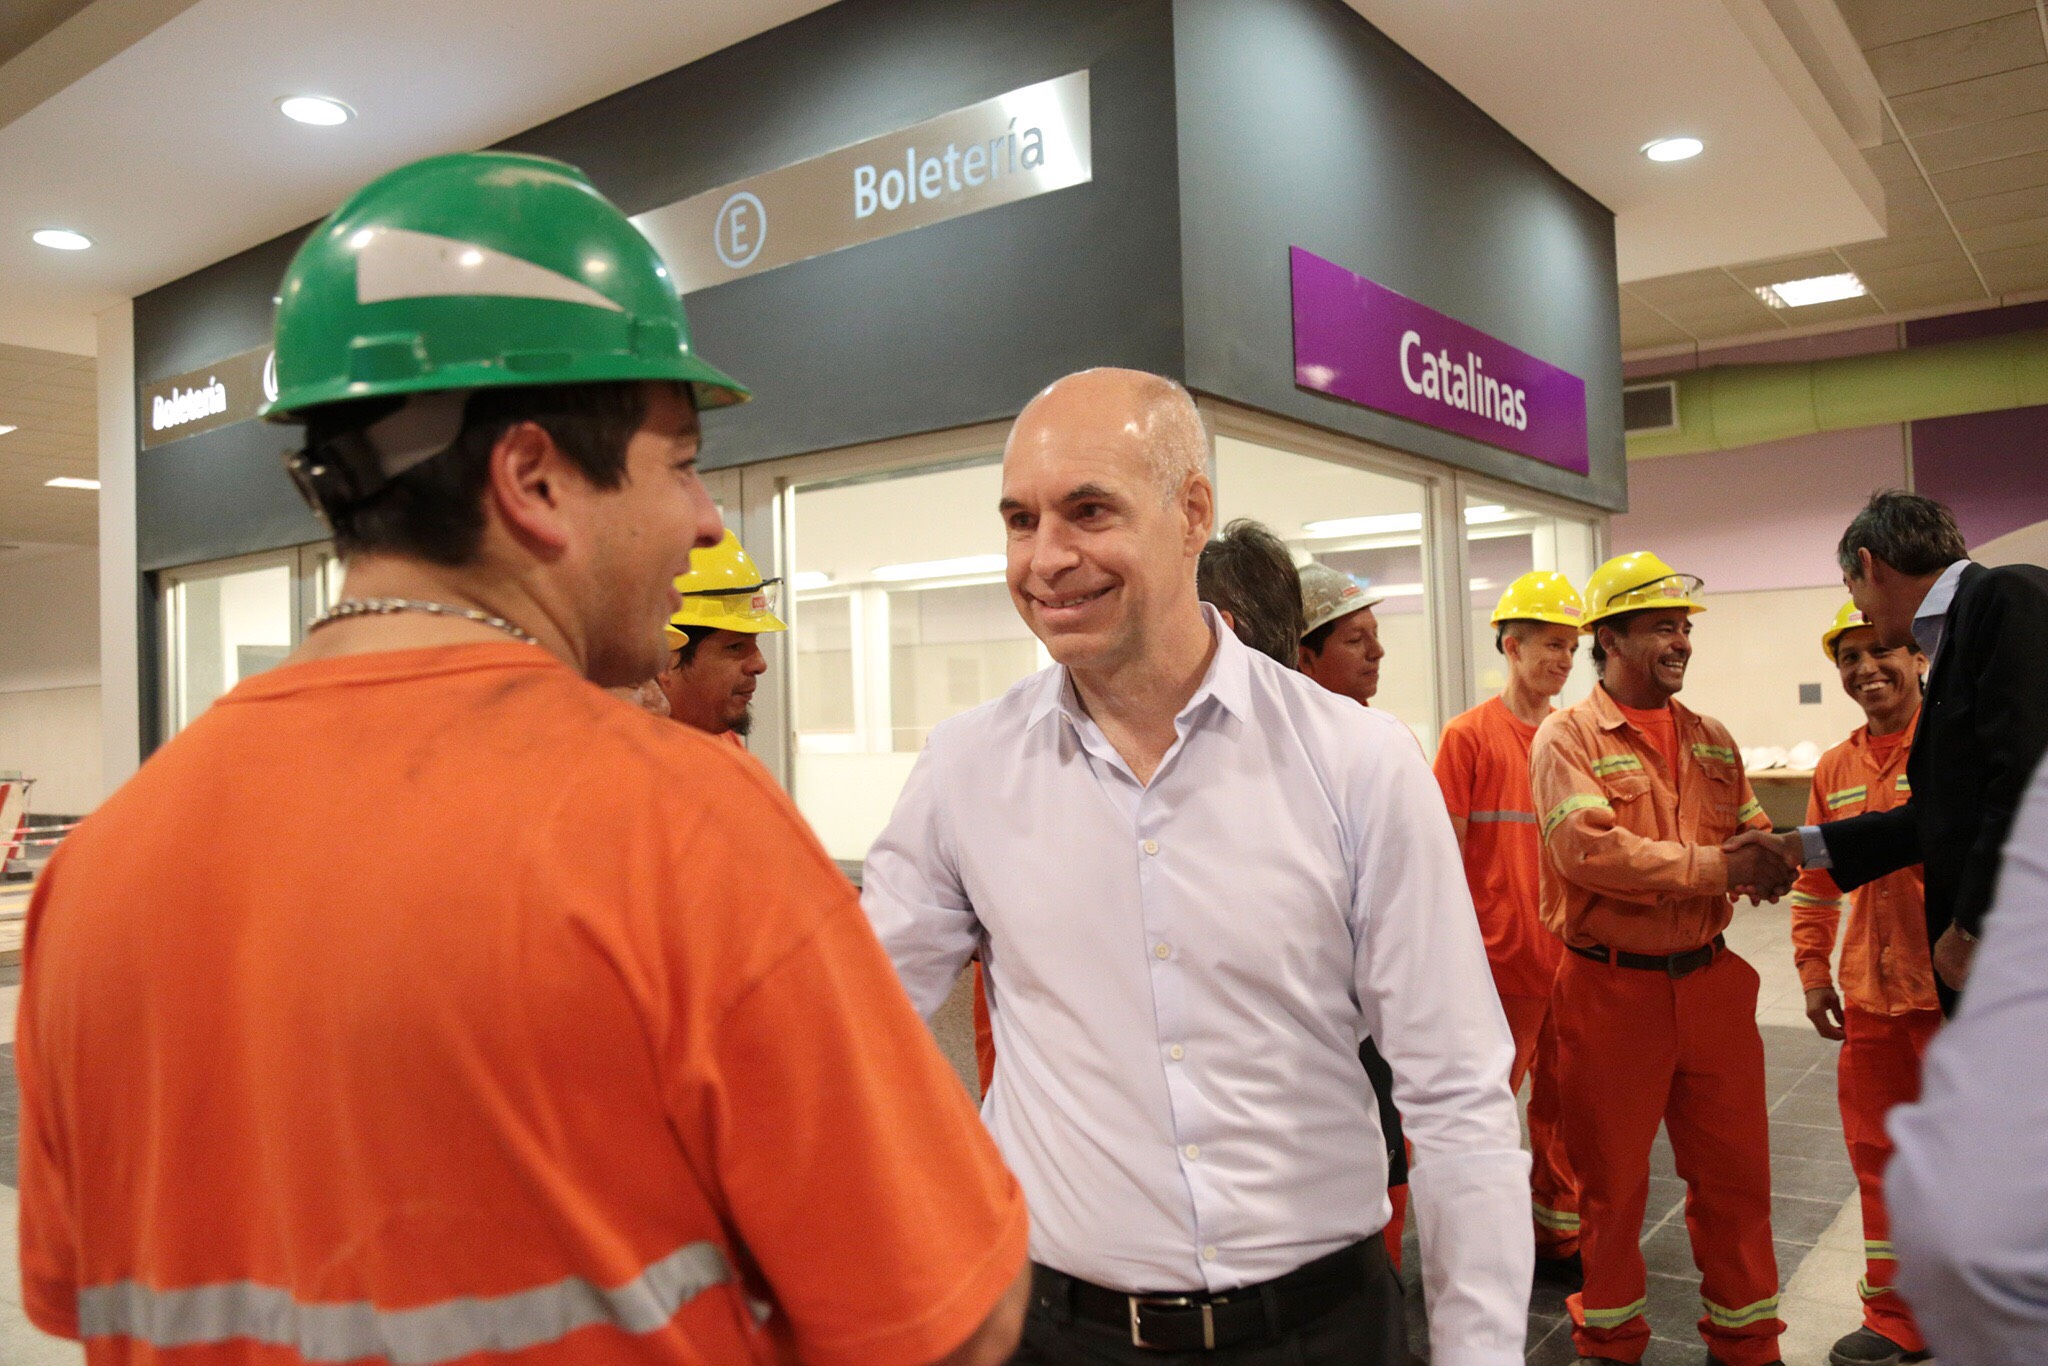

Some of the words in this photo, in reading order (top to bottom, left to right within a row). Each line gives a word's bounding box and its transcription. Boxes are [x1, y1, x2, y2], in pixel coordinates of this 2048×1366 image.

[729, 204, 749, 255] E
[854, 117, 1045, 219] Boletería
[152, 375, 227, 430] Boletería
[1400, 330, 1528, 431] Catalinas
